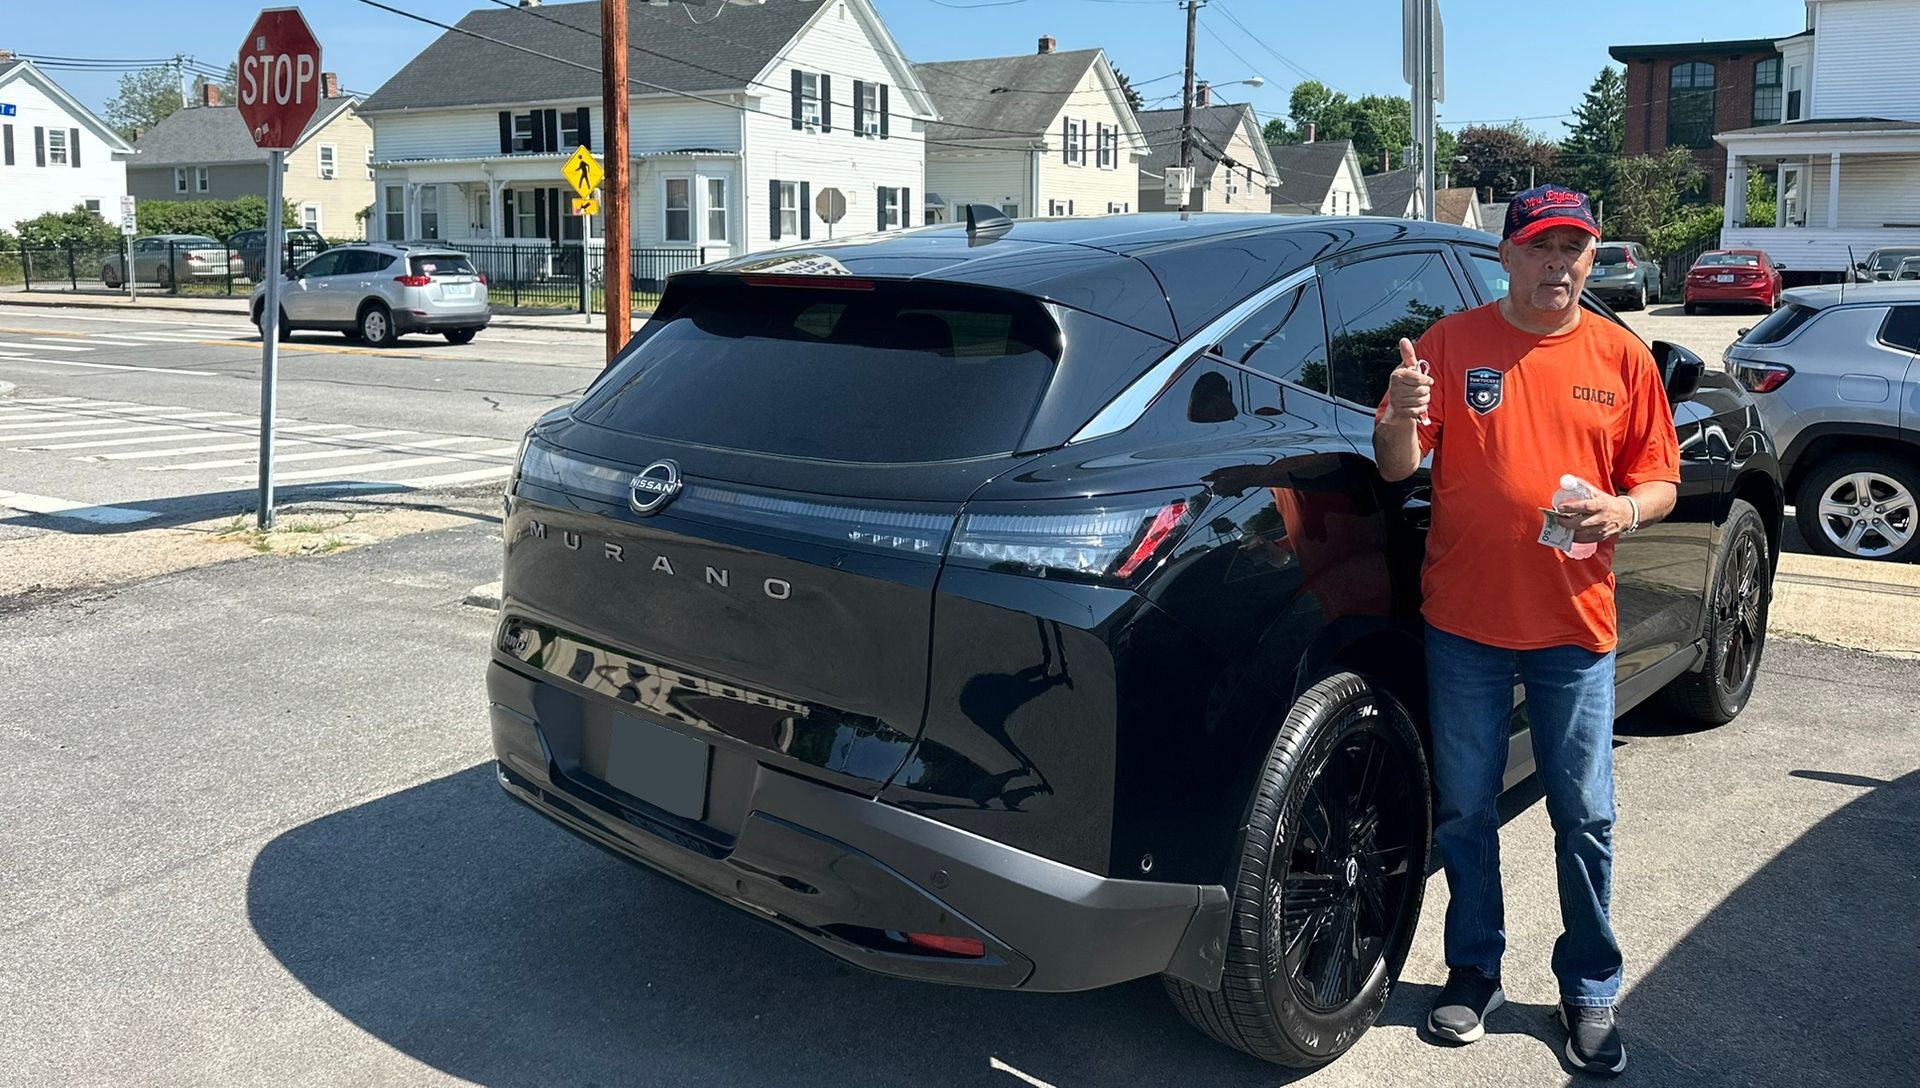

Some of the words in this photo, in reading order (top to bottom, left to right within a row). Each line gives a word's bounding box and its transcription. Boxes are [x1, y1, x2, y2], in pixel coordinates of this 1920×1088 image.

[242, 53, 314, 105] STOP
[1524, 196, 1543, 209] New
[1545, 190, 1579, 204] England
[1572, 385, 1615, 406] COACH
[630, 478, 674, 493] NISSAN
[1542, 530, 1551, 541] 50
[529, 520, 791, 600] MURANO
